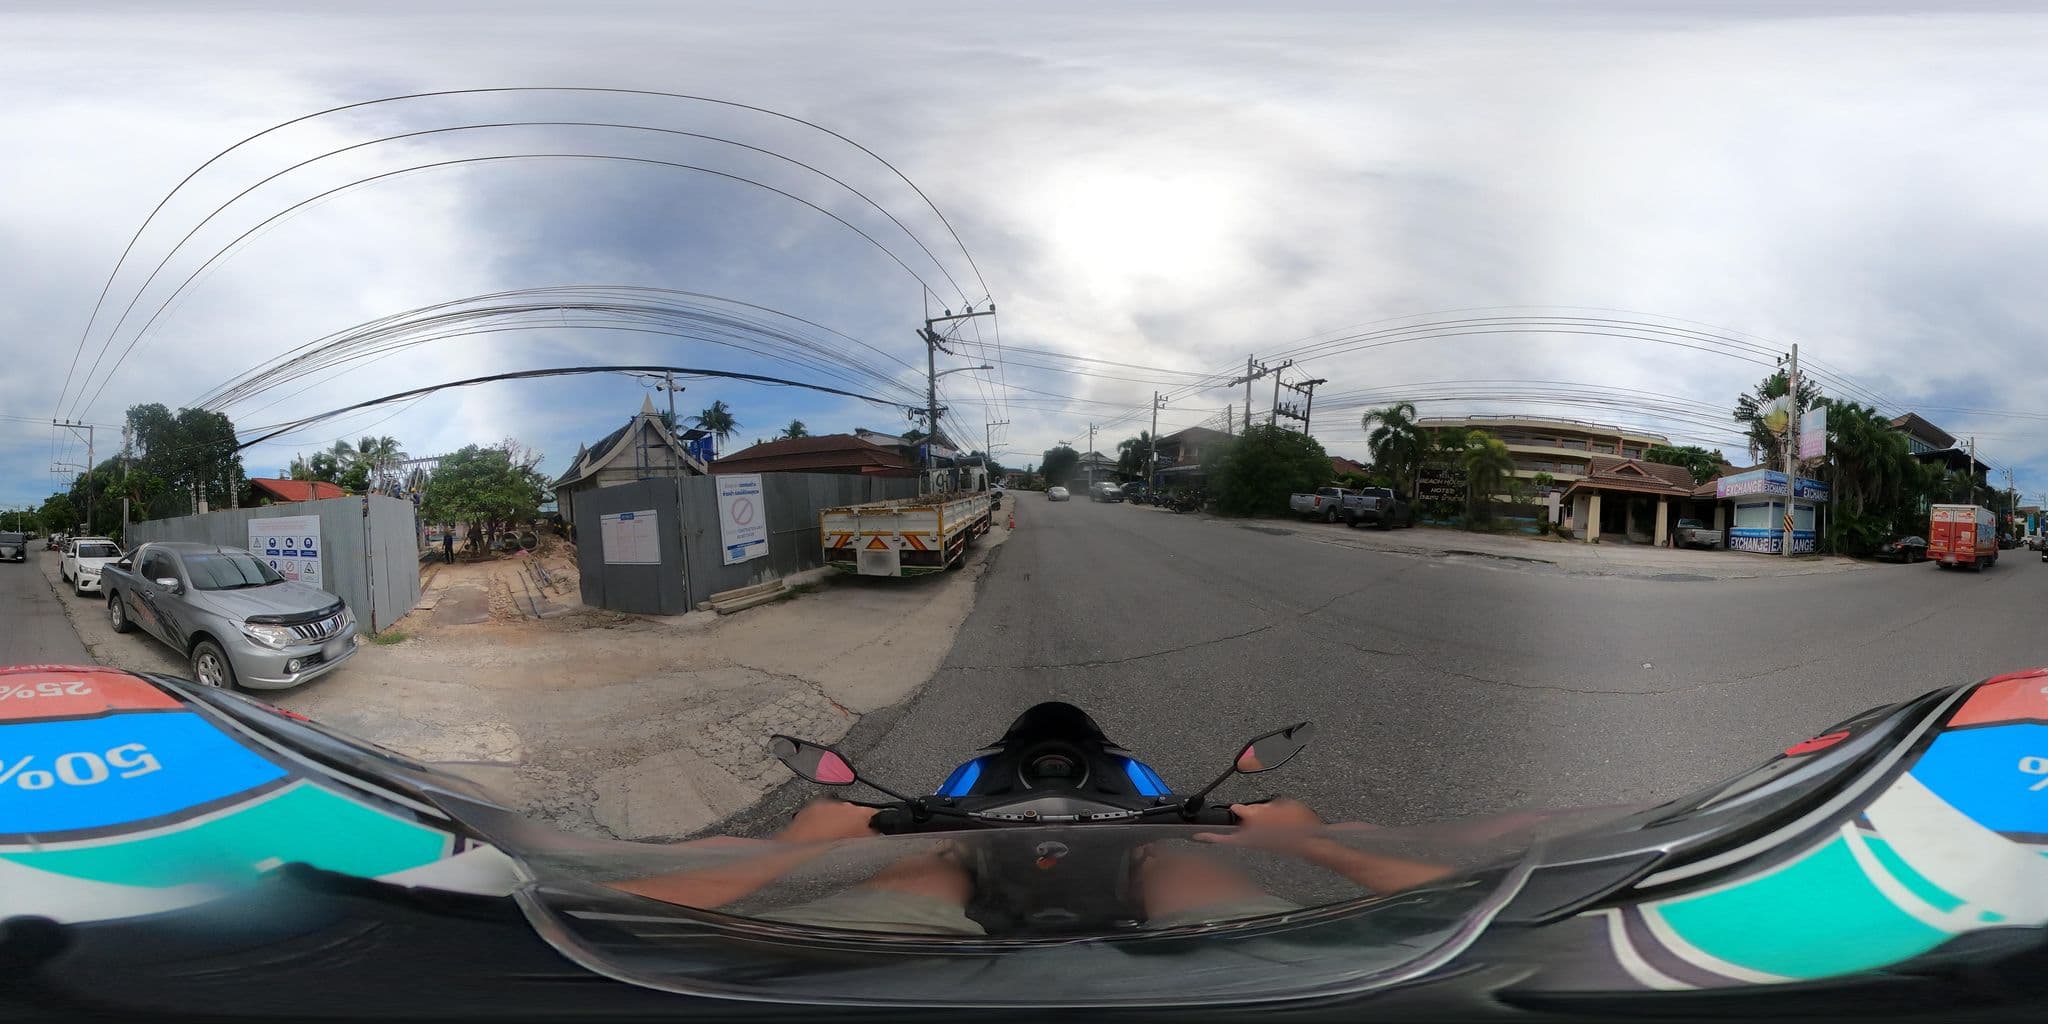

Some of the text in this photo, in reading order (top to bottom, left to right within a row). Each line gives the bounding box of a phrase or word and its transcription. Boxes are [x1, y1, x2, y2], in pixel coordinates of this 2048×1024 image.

[1726, 480, 1762, 497] EXCHANGE
[1764, 483, 1788, 496] ECHANGE
[1803, 487, 1829, 501] EXCHANGE
[1731, 537, 1769, 552] EXCHANGE
[1771, 538, 1815, 553] EXANGE
[0, 681, 92, 700] 25%
[0, 743, 162, 790] 50%
